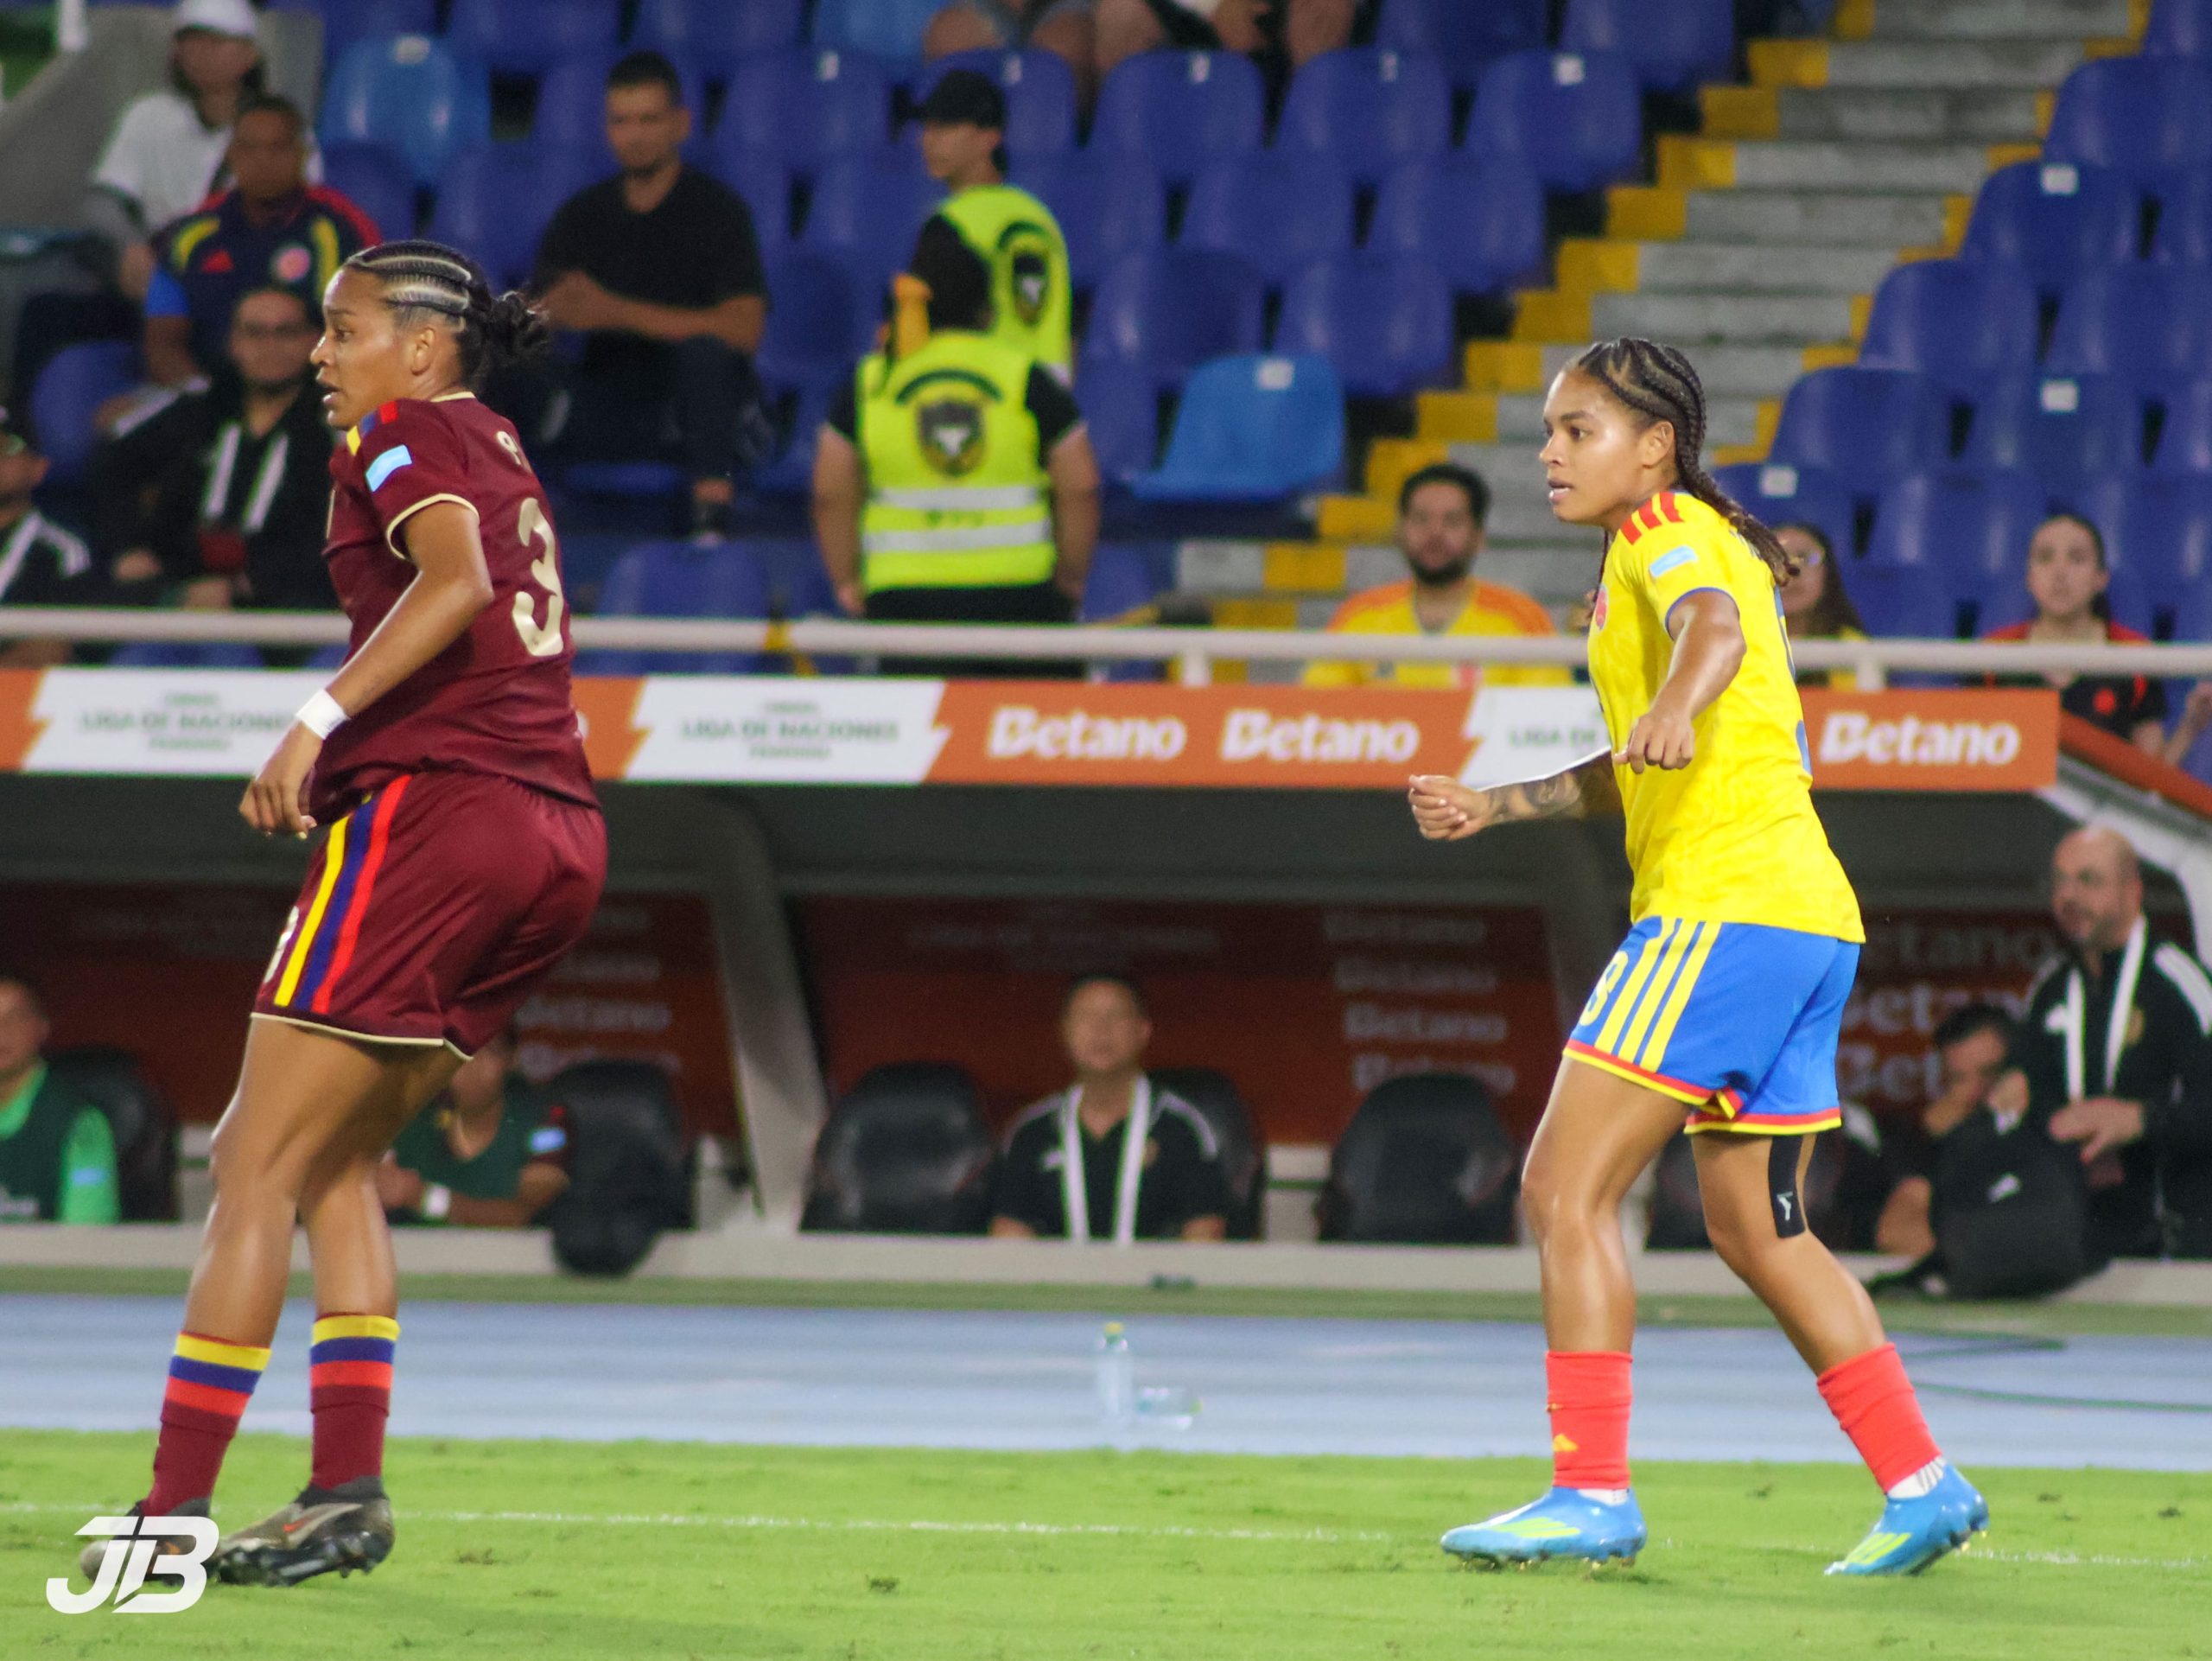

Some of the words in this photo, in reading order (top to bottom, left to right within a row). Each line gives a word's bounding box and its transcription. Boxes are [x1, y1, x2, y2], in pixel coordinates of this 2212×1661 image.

[512, 497, 564, 657] 3
[988, 707, 1186, 760] Betano
[1221, 710, 1420, 762] Betano
[1821, 713, 2020, 765] Betano
